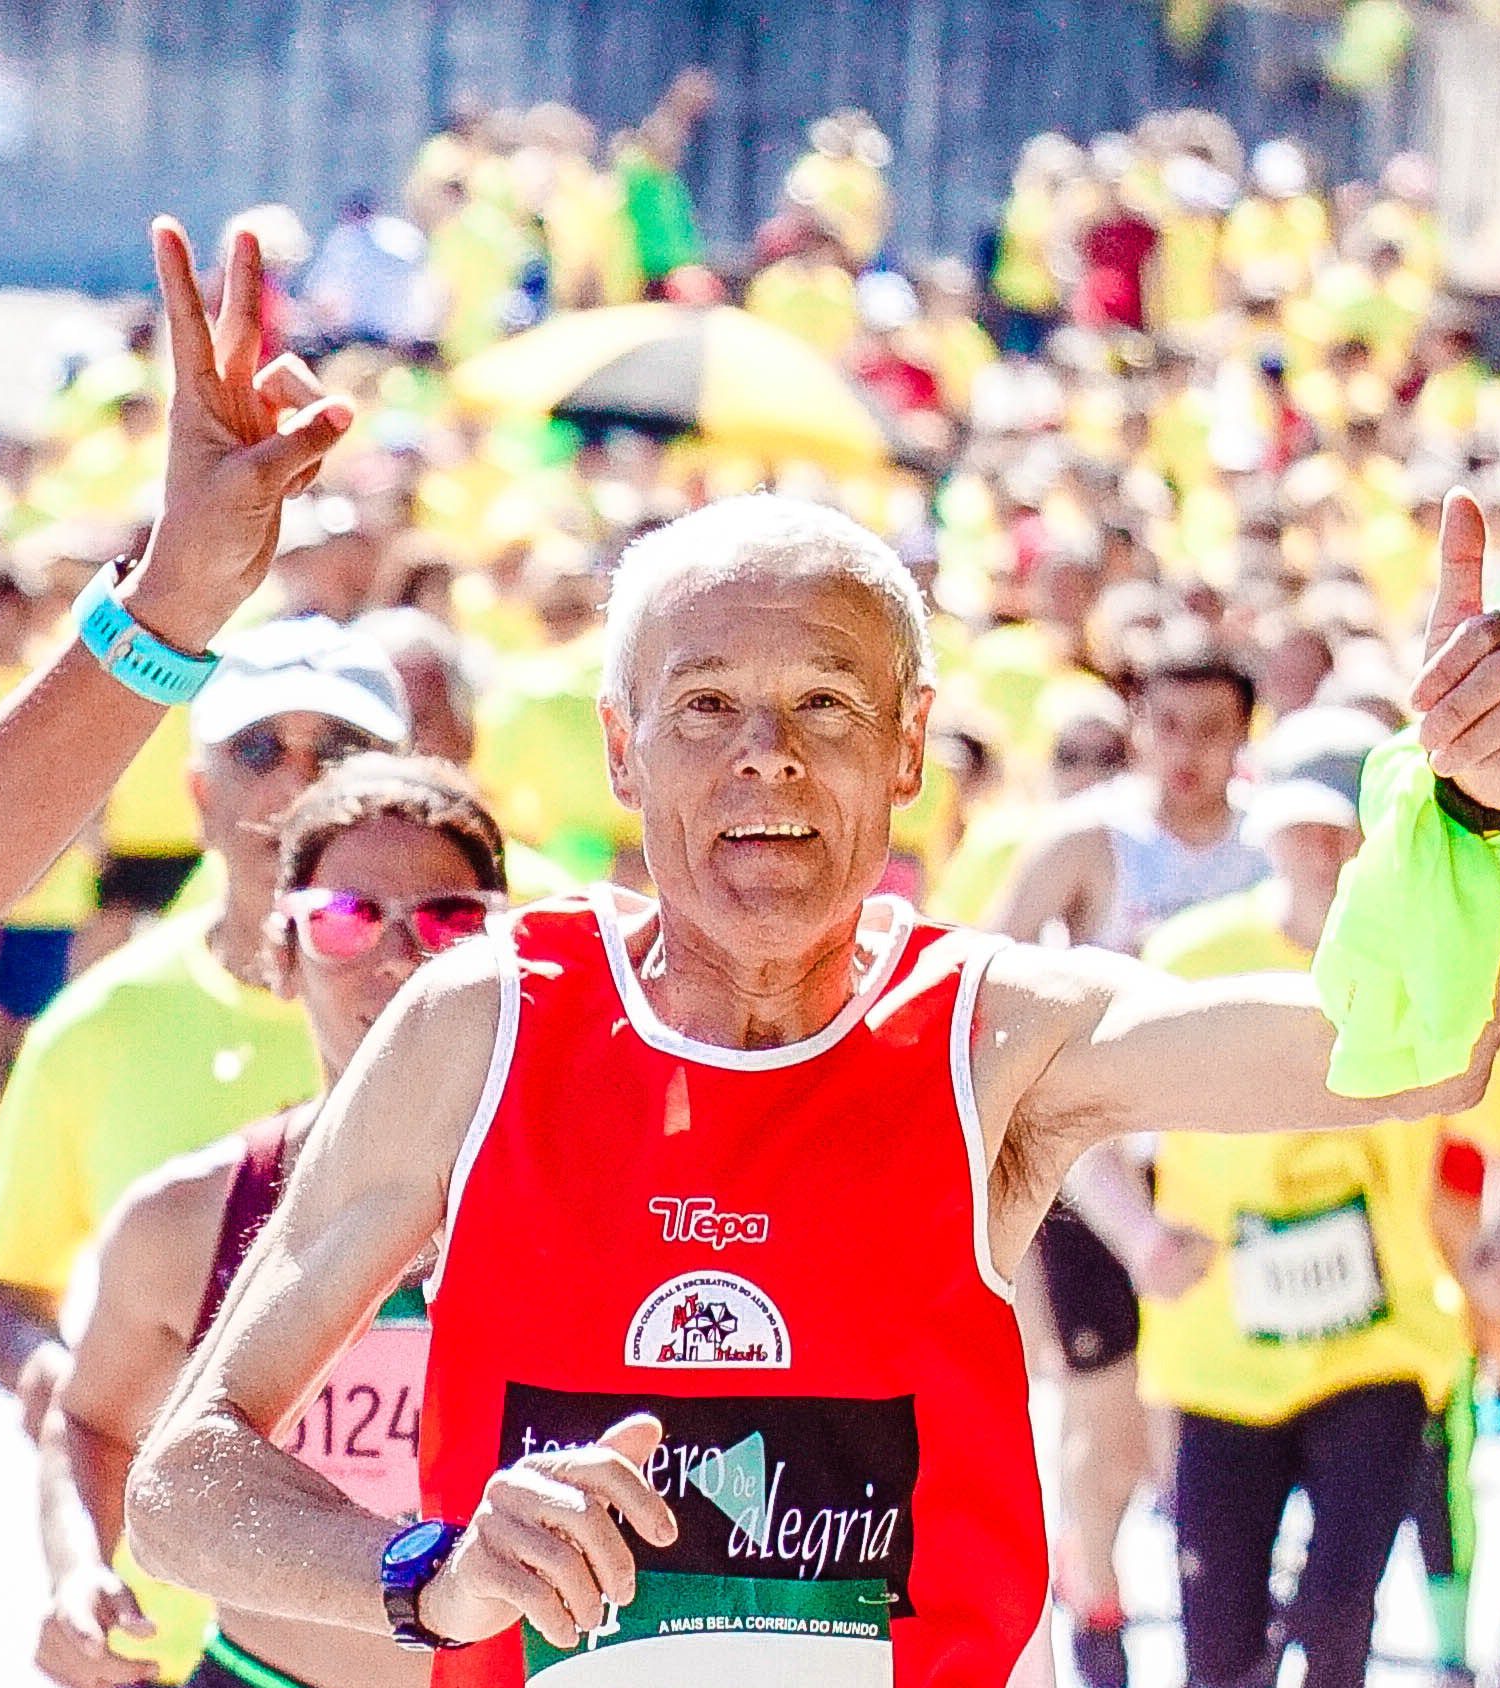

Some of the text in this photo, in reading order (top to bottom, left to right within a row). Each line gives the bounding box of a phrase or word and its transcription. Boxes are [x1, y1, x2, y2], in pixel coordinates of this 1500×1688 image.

[732, 1466, 757, 1498] de
[727, 1461, 899, 1580] alegria
[659, 1615, 879, 1637] A MAIS BELA CORRIDA DO MUNDO
